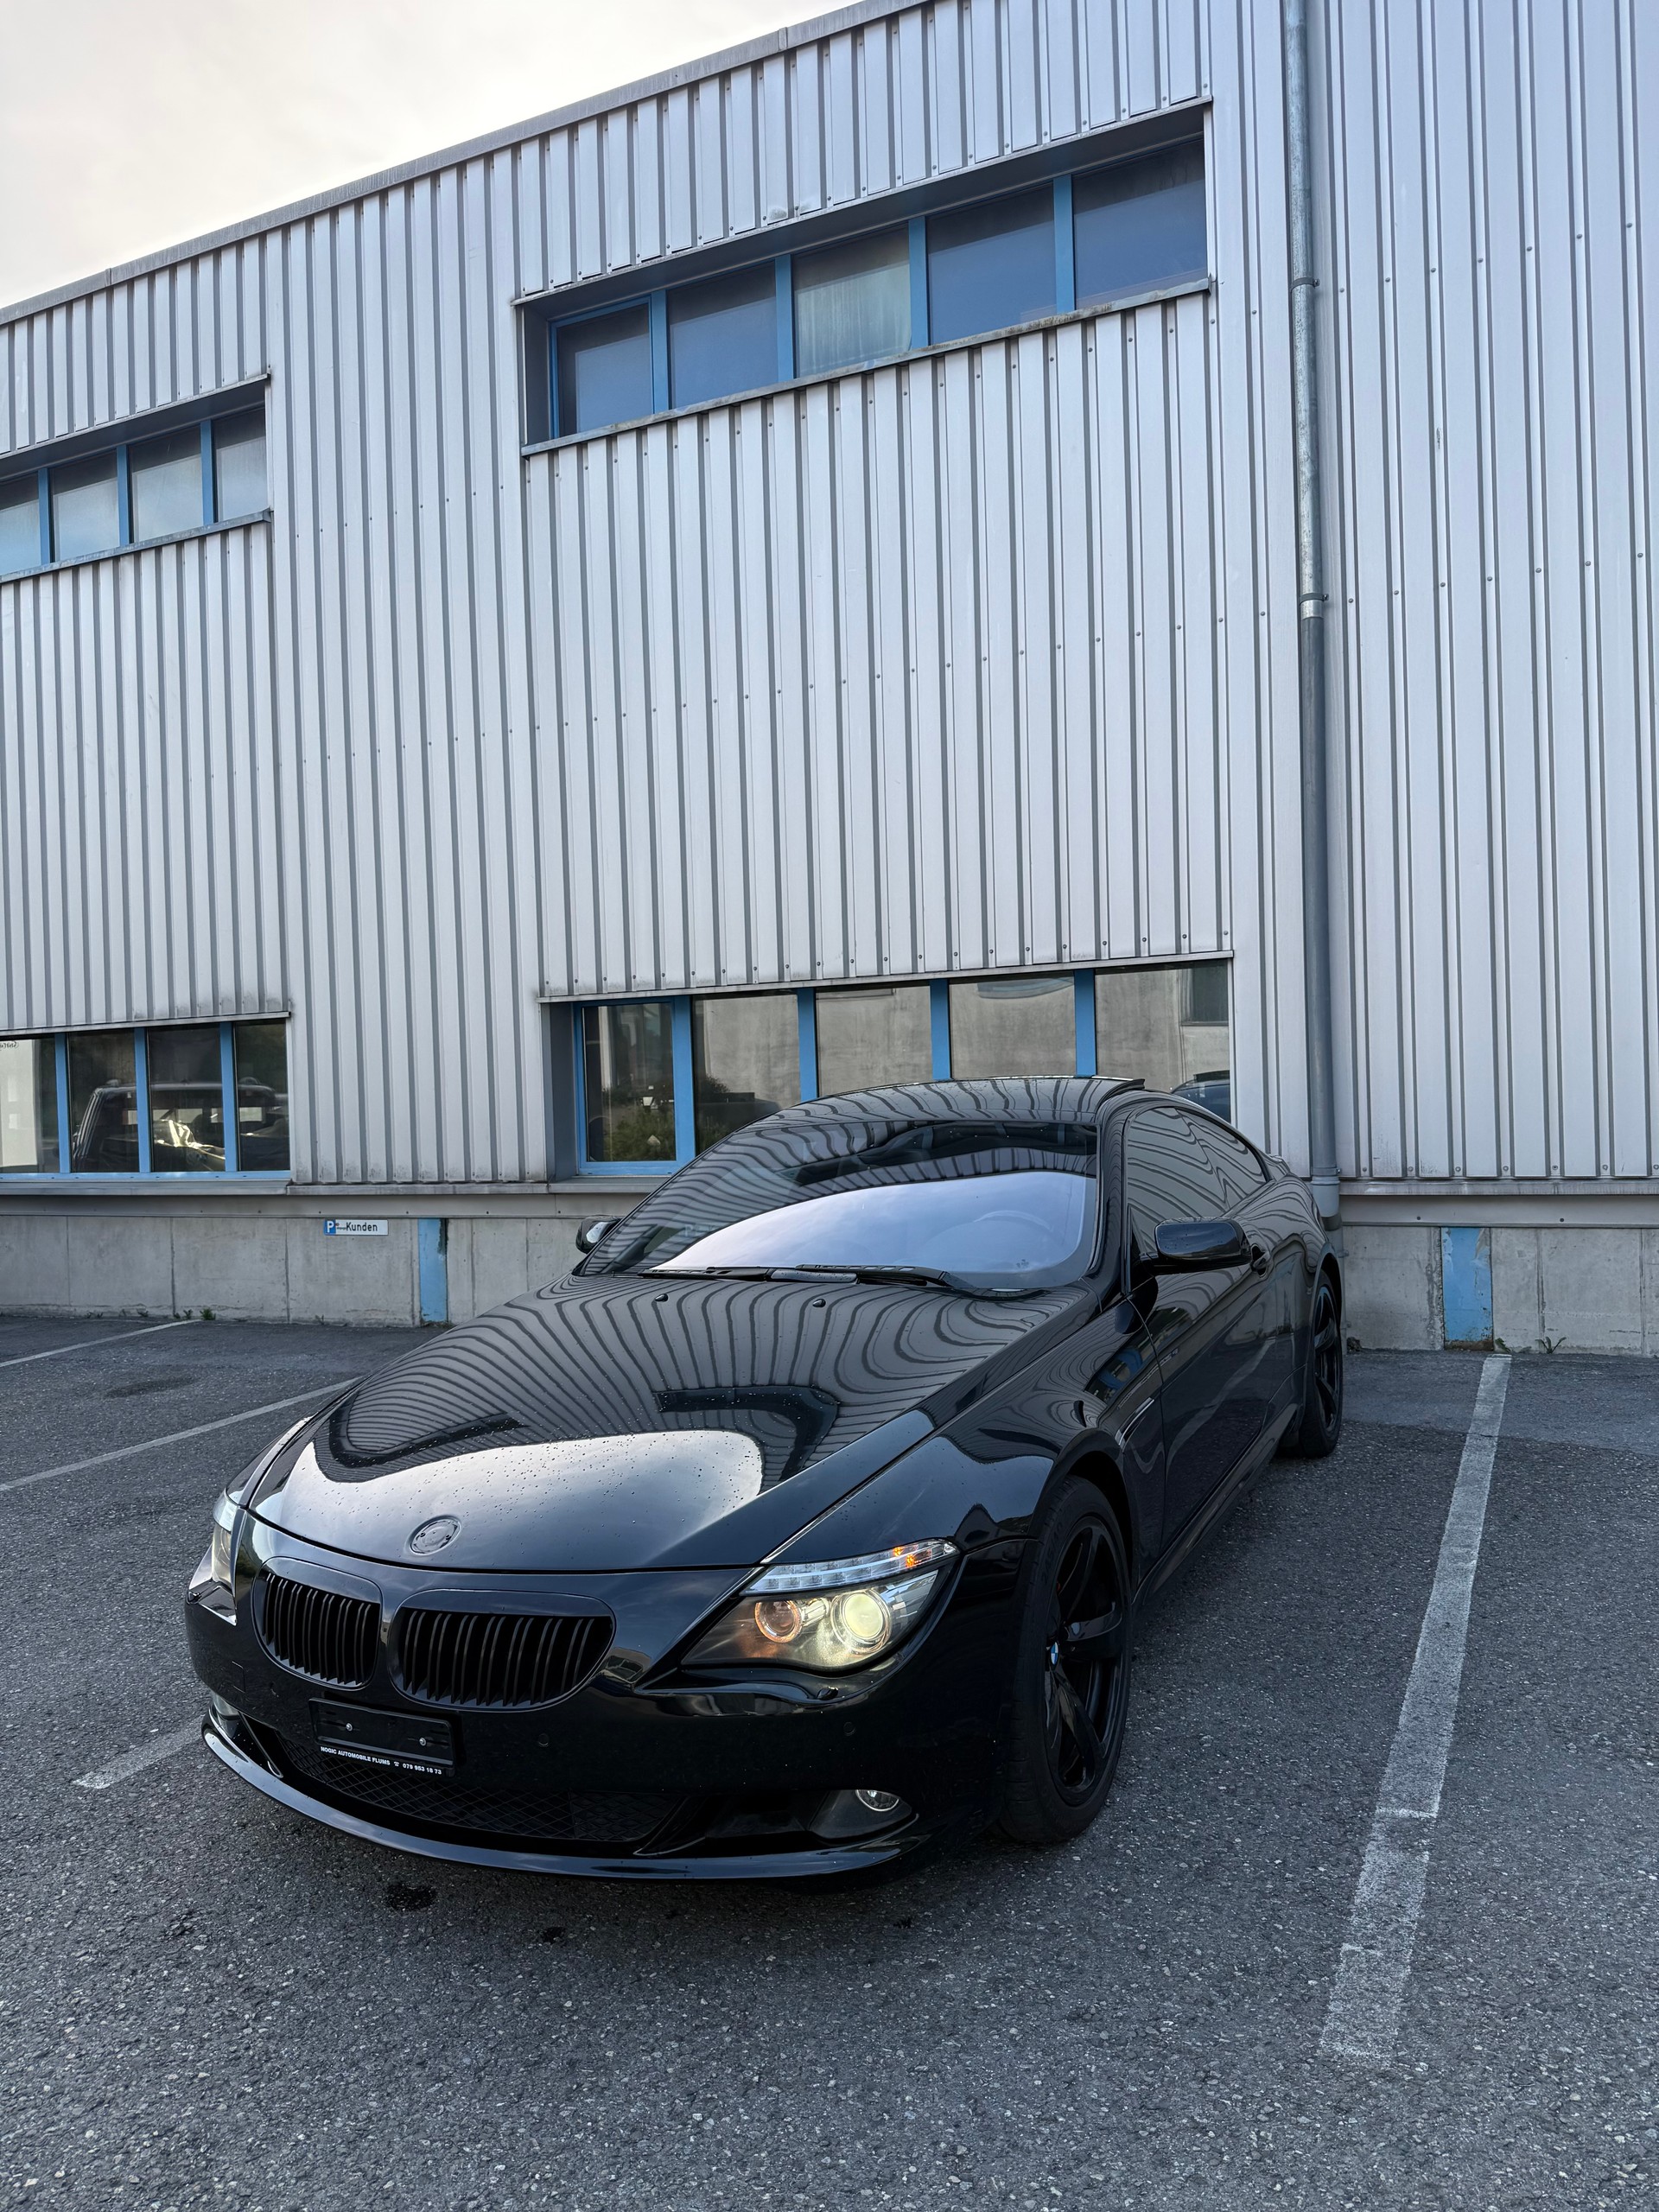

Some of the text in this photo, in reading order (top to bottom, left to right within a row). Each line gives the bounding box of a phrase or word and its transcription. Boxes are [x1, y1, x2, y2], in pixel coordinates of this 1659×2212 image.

[327, 1221, 378, 1233] P Kunden
[337, 1750, 372, 1762] AUTOMOBILE
[372, 1757, 391, 1765] FLUMS
